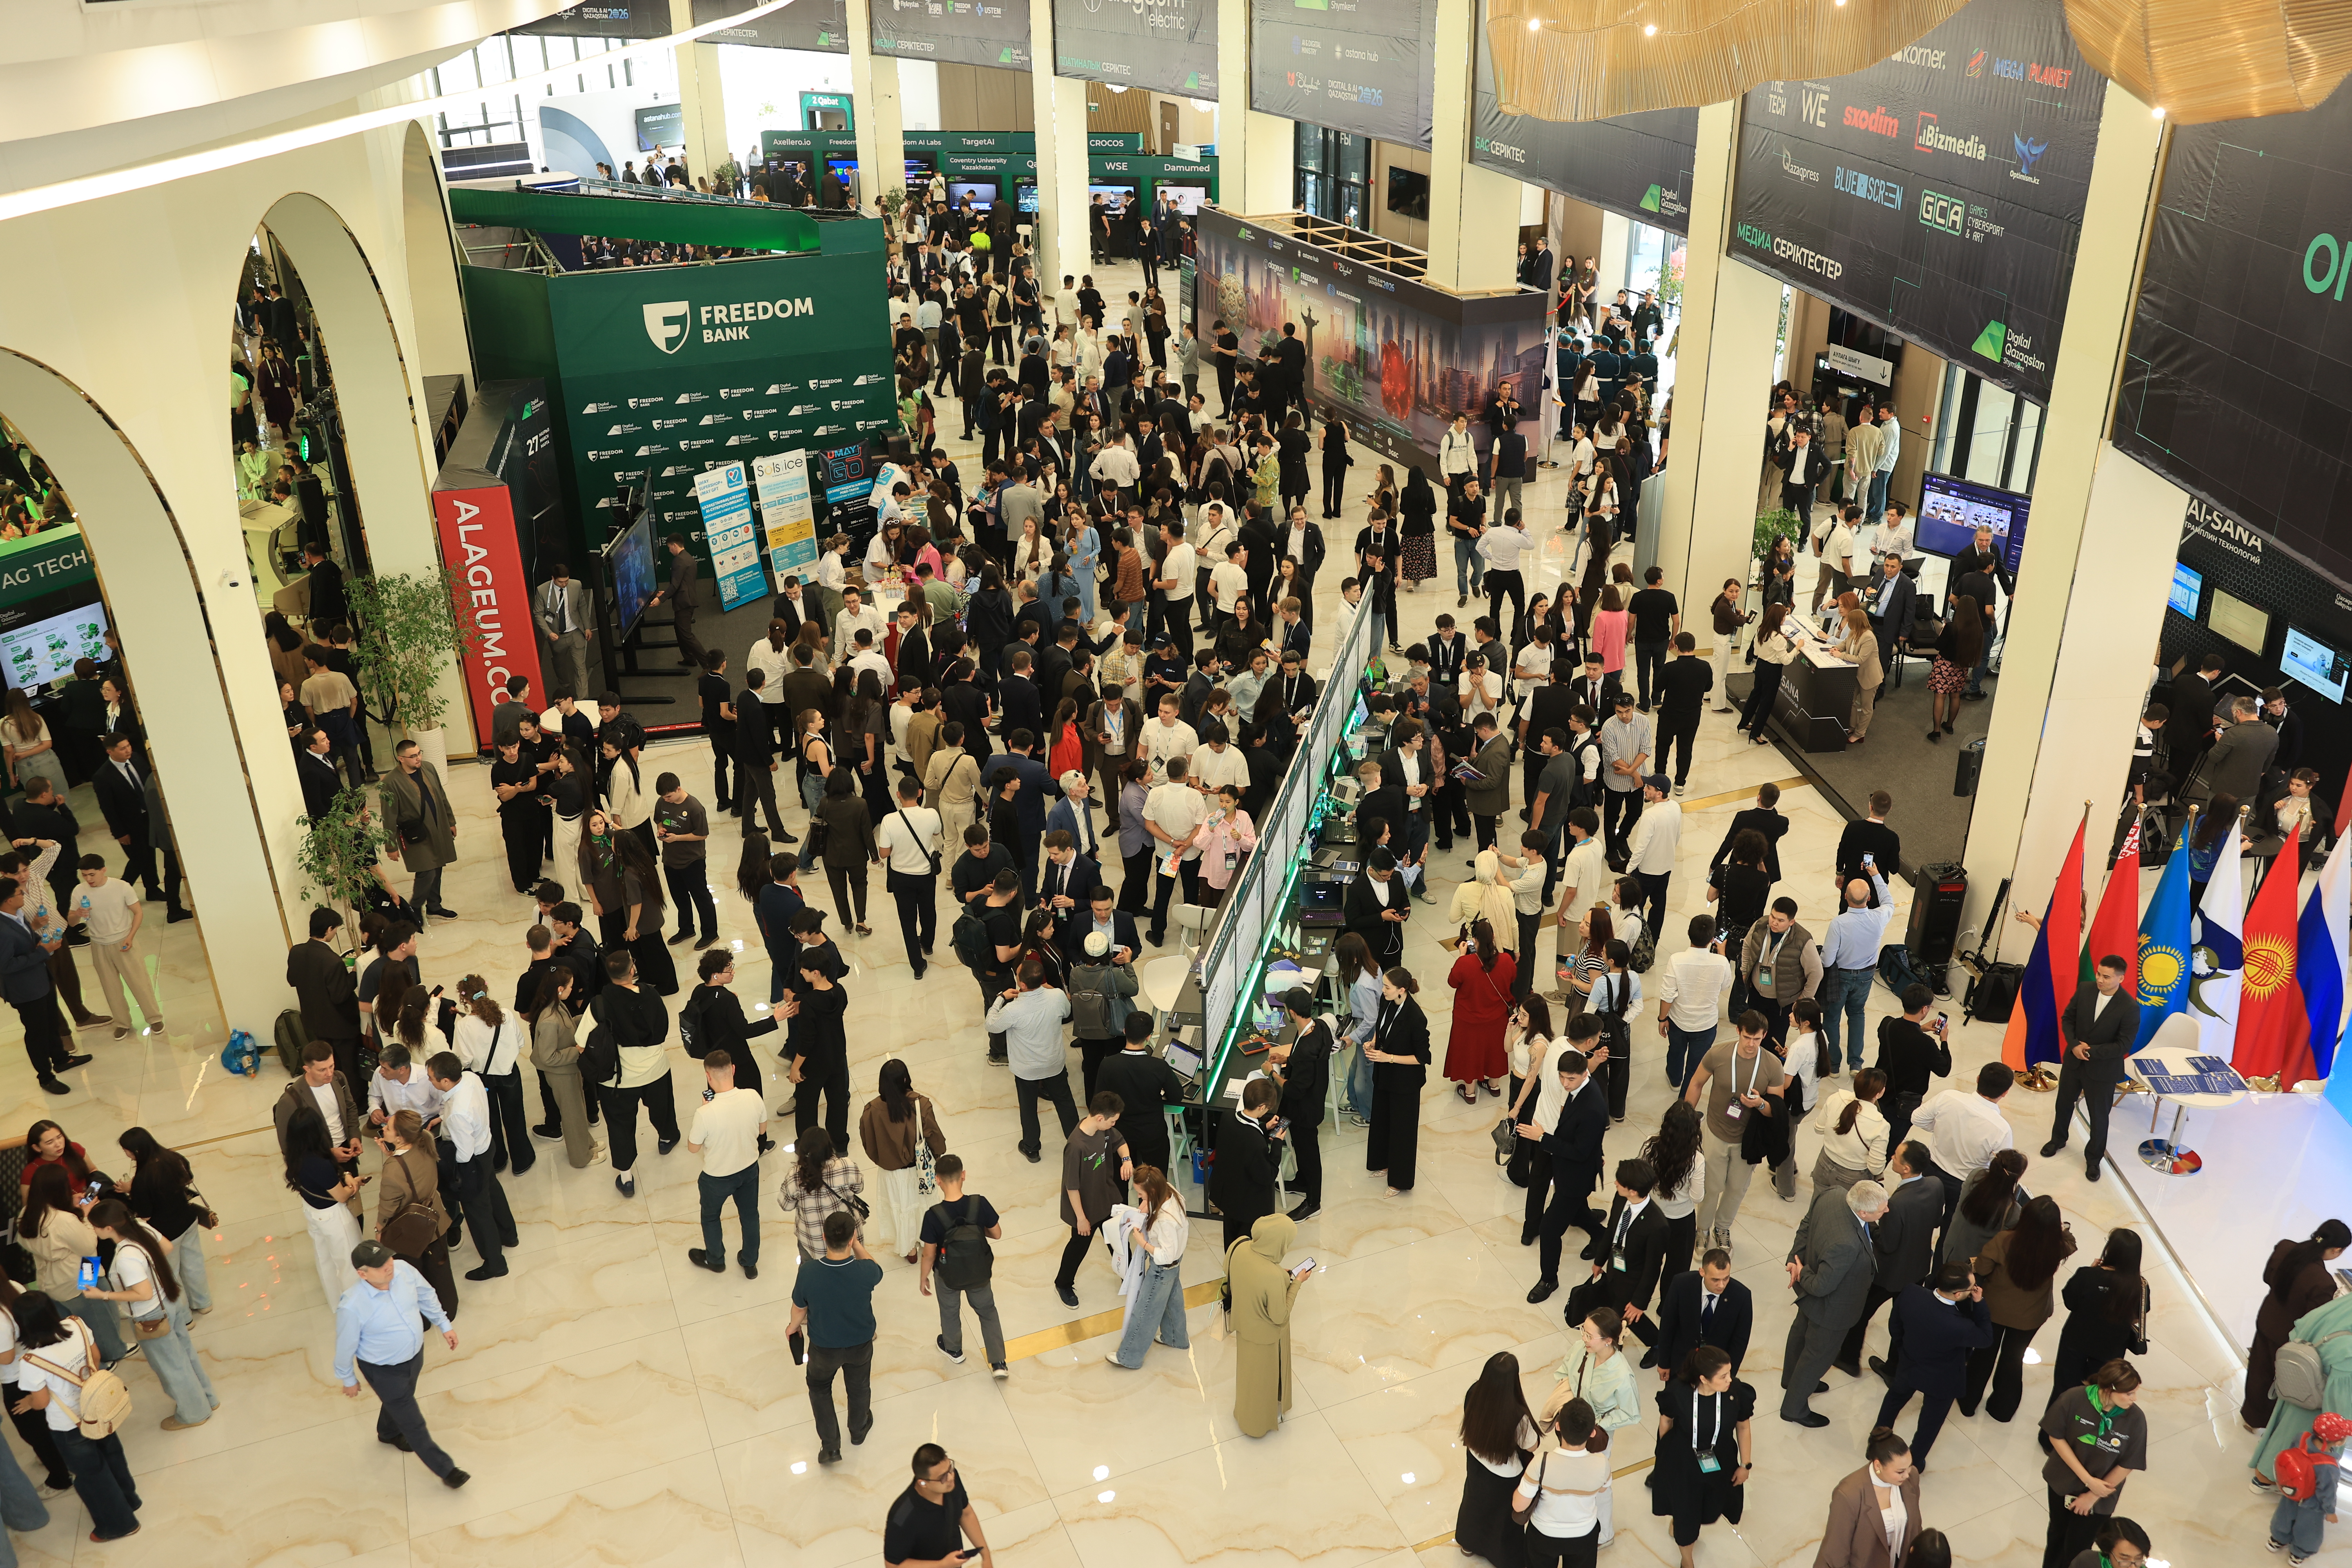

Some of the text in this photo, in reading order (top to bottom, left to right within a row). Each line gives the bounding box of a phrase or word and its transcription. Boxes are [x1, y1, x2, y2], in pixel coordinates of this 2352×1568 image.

[1331, 1, 1356, 12] Shymkent
[1149, 9, 1185, 30] electric
[875, 38, 935, 52] МЕДИА СЕРІКТЕСТЕР
[1301, 47, 1317, 55] MINISTRY
[1308, 40, 1321, 49] DIGITAL
[1345, 48, 1379, 62] astana hub
[1059, 56, 1131, 75] ПЛАТИНАЛЫҚ СЕРІКТЕС
[1993, 57, 2072, 89] MEGA PLANET
[1199, 79, 1217, 87] Qazaqstan
[1328, 79, 1347, 91] DIGITAL
[1352, 84, 1357, 93] AI
[1771, 81, 1784, 94] THE
[818, 96, 838, 106] Qabat
[1328, 89, 1357, 102] QAZAQSTAN
[1769, 94, 1786, 116] TECH
[1802, 89, 1829, 128] WE
[1843, 105, 1899, 138] sxodim
[1475, 136, 1526, 163] БАС СЕРІКТЕС
[1924, 124, 1986, 161] Bizmedia
[1783, 144, 1819, 182] Qazaqpress
[1834, 166, 1858, 195] BLUE
[2009, 170, 2040, 185] Optimism.kz
[1662, 188, 1677, 200] Digital
[1661, 199, 1687, 214] Qazaqstan
[1661, 208, 1675, 217] Shymkent
[1922, 196, 1962, 230] GCA
[1969, 204, 1987, 218] GAMES
[1967, 216, 2004, 237] CYBERSPORT
[1965, 229, 1984, 243] & ART
[1302, 252, 1312, 261] astana
[1737, 221, 1842, 280] МЕДИА СЕРІКТЕСТЕР
[1269, 260, 1285, 274] alageum
[1300, 272, 1318, 285] FREEDOM
[1305, 295, 1323, 307] DAMUMED
[1336, 290, 1361, 304] ҚАЗАҚТЕЛЕКОМ
[701, 297, 813, 325] FREEDOM
[1334, 306, 1343, 316] VISA
[703, 326, 750, 343] BANK
[2007, 328, 2031, 349] Digital
[1833, 351, 1860, 365] АУЛАҒА ШЫҒУ
[2005, 343, 2045, 371] Qazaqstan
[2003, 357, 2025, 373] Shymkent
[539, 427, 550, 437] НАУРЫЗ
[540, 434, 549, 443] MARCH
[526, 435, 538, 456] 27
[541, 440, 550, 448] МАРТА
[827, 445, 859, 459] UMAY
[1388, 448, 1399, 459] DGSC
[757, 459, 803, 477] Solstice
[699, 481, 722, 491] SUPERSHOP+
[2187, 499, 2262, 552] AI-SANA
[2185, 521, 2261, 565] ТРАМПЛИН ТЕХНОЛОГИЙ
[2, 550, 88, 589] AG TECH
[453, 499, 512, 707] ALAGEUM.CO
[0, 610, 15, 619] Digital
[1, 612, 26, 623] Qazaqstan
[16, 628, 38, 638] AGGREGATOR
[1245, 862, 1255, 886] Coyote
[1208, 911, 1234, 972] Aqbobek Lyceum
[2080, 1418, 2095, 1426] FREEDOM
[2096, 1441, 2120, 1454] Qazaqstan
[2097, 1437, 2112, 1447] Digital
